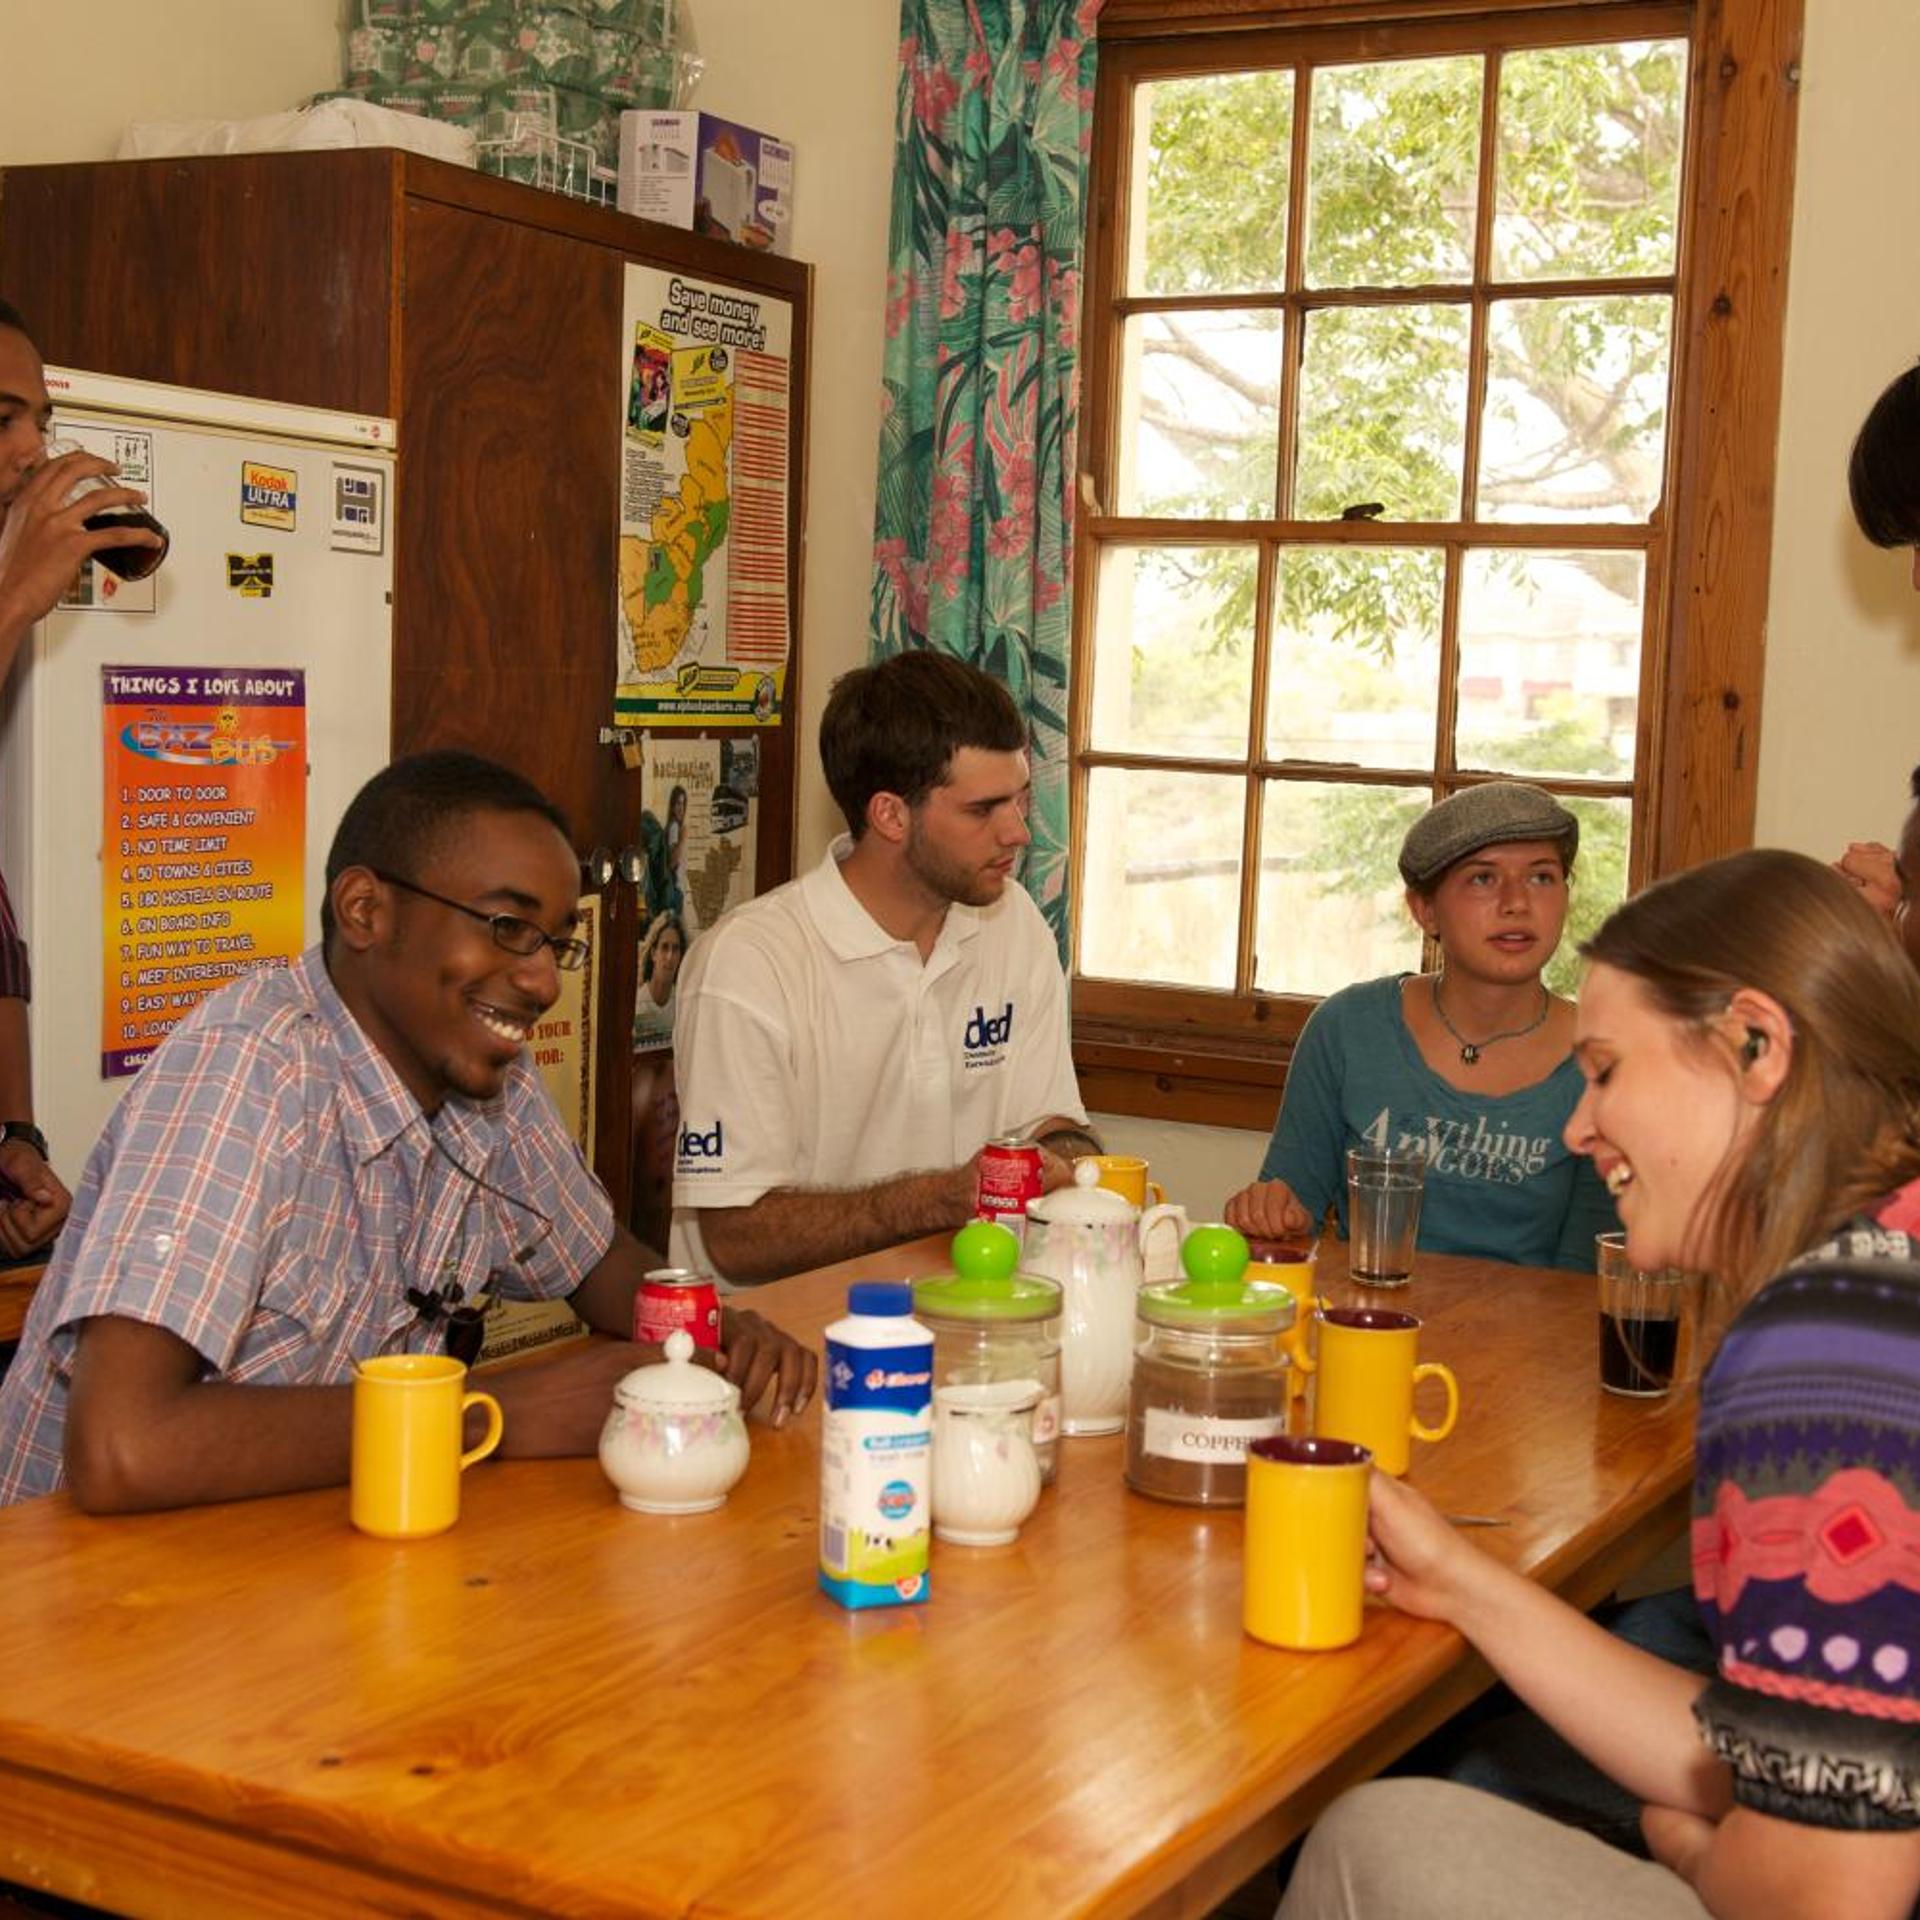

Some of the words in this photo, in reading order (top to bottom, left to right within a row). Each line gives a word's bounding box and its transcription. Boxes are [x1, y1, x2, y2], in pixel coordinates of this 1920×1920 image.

[670, 279, 706, 311] Save
[709, 293, 759, 329] money
[660, 310, 690, 335] and
[692, 316, 719, 342] see
[720, 323, 766, 352] more!
[250, 470, 289, 490] Kodak
[247, 487, 290, 507] ULTRA
[110, 676, 181, 695] THINGS
[185, 678, 199, 694] I
[204, 678, 240, 696] LOVE
[245, 679, 296, 697] ABOUT
[138, 788, 171, 802] DOOR
[176, 787, 192, 800] TO
[196, 786, 227, 800] DOOR
[122, 815, 133, 829] 2.
[138, 813, 168, 829] SAFE
[184, 810, 256, 826] CONVENIENT
[122, 841, 134, 856] 3.
[138, 840, 156, 855] NO
[161, 838, 192, 854] TIME
[195, 836, 227, 852] LIMIT
[158, 863, 200, 880] TOWNS
[214, 860, 252, 876] CITIES
[121, 893, 133, 908] 5.
[162, 887, 214, 906] HOSTELS
[137, 917, 157, 933] ON
[160, 914, 197, 933] BOARD
[201, 911, 231, 929] INFO
[137, 943, 162, 960] FUN
[166, 940, 193, 957] WAY
[196, 939, 211, 954] TO
[214, 934, 255, 953] TRAVEL
[121, 973, 133, 988] 8.
[138, 968, 169, 986] MEET
[121, 999, 133, 1014] 9.
[138, 994, 167, 1012] EASY
[172, 991, 197, 1008] WAY
[538, 1020, 572, 1040] YOUR
[535, 1048, 564, 1067] FOR:
[1182, 1431, 1254, 1451] COFFE
